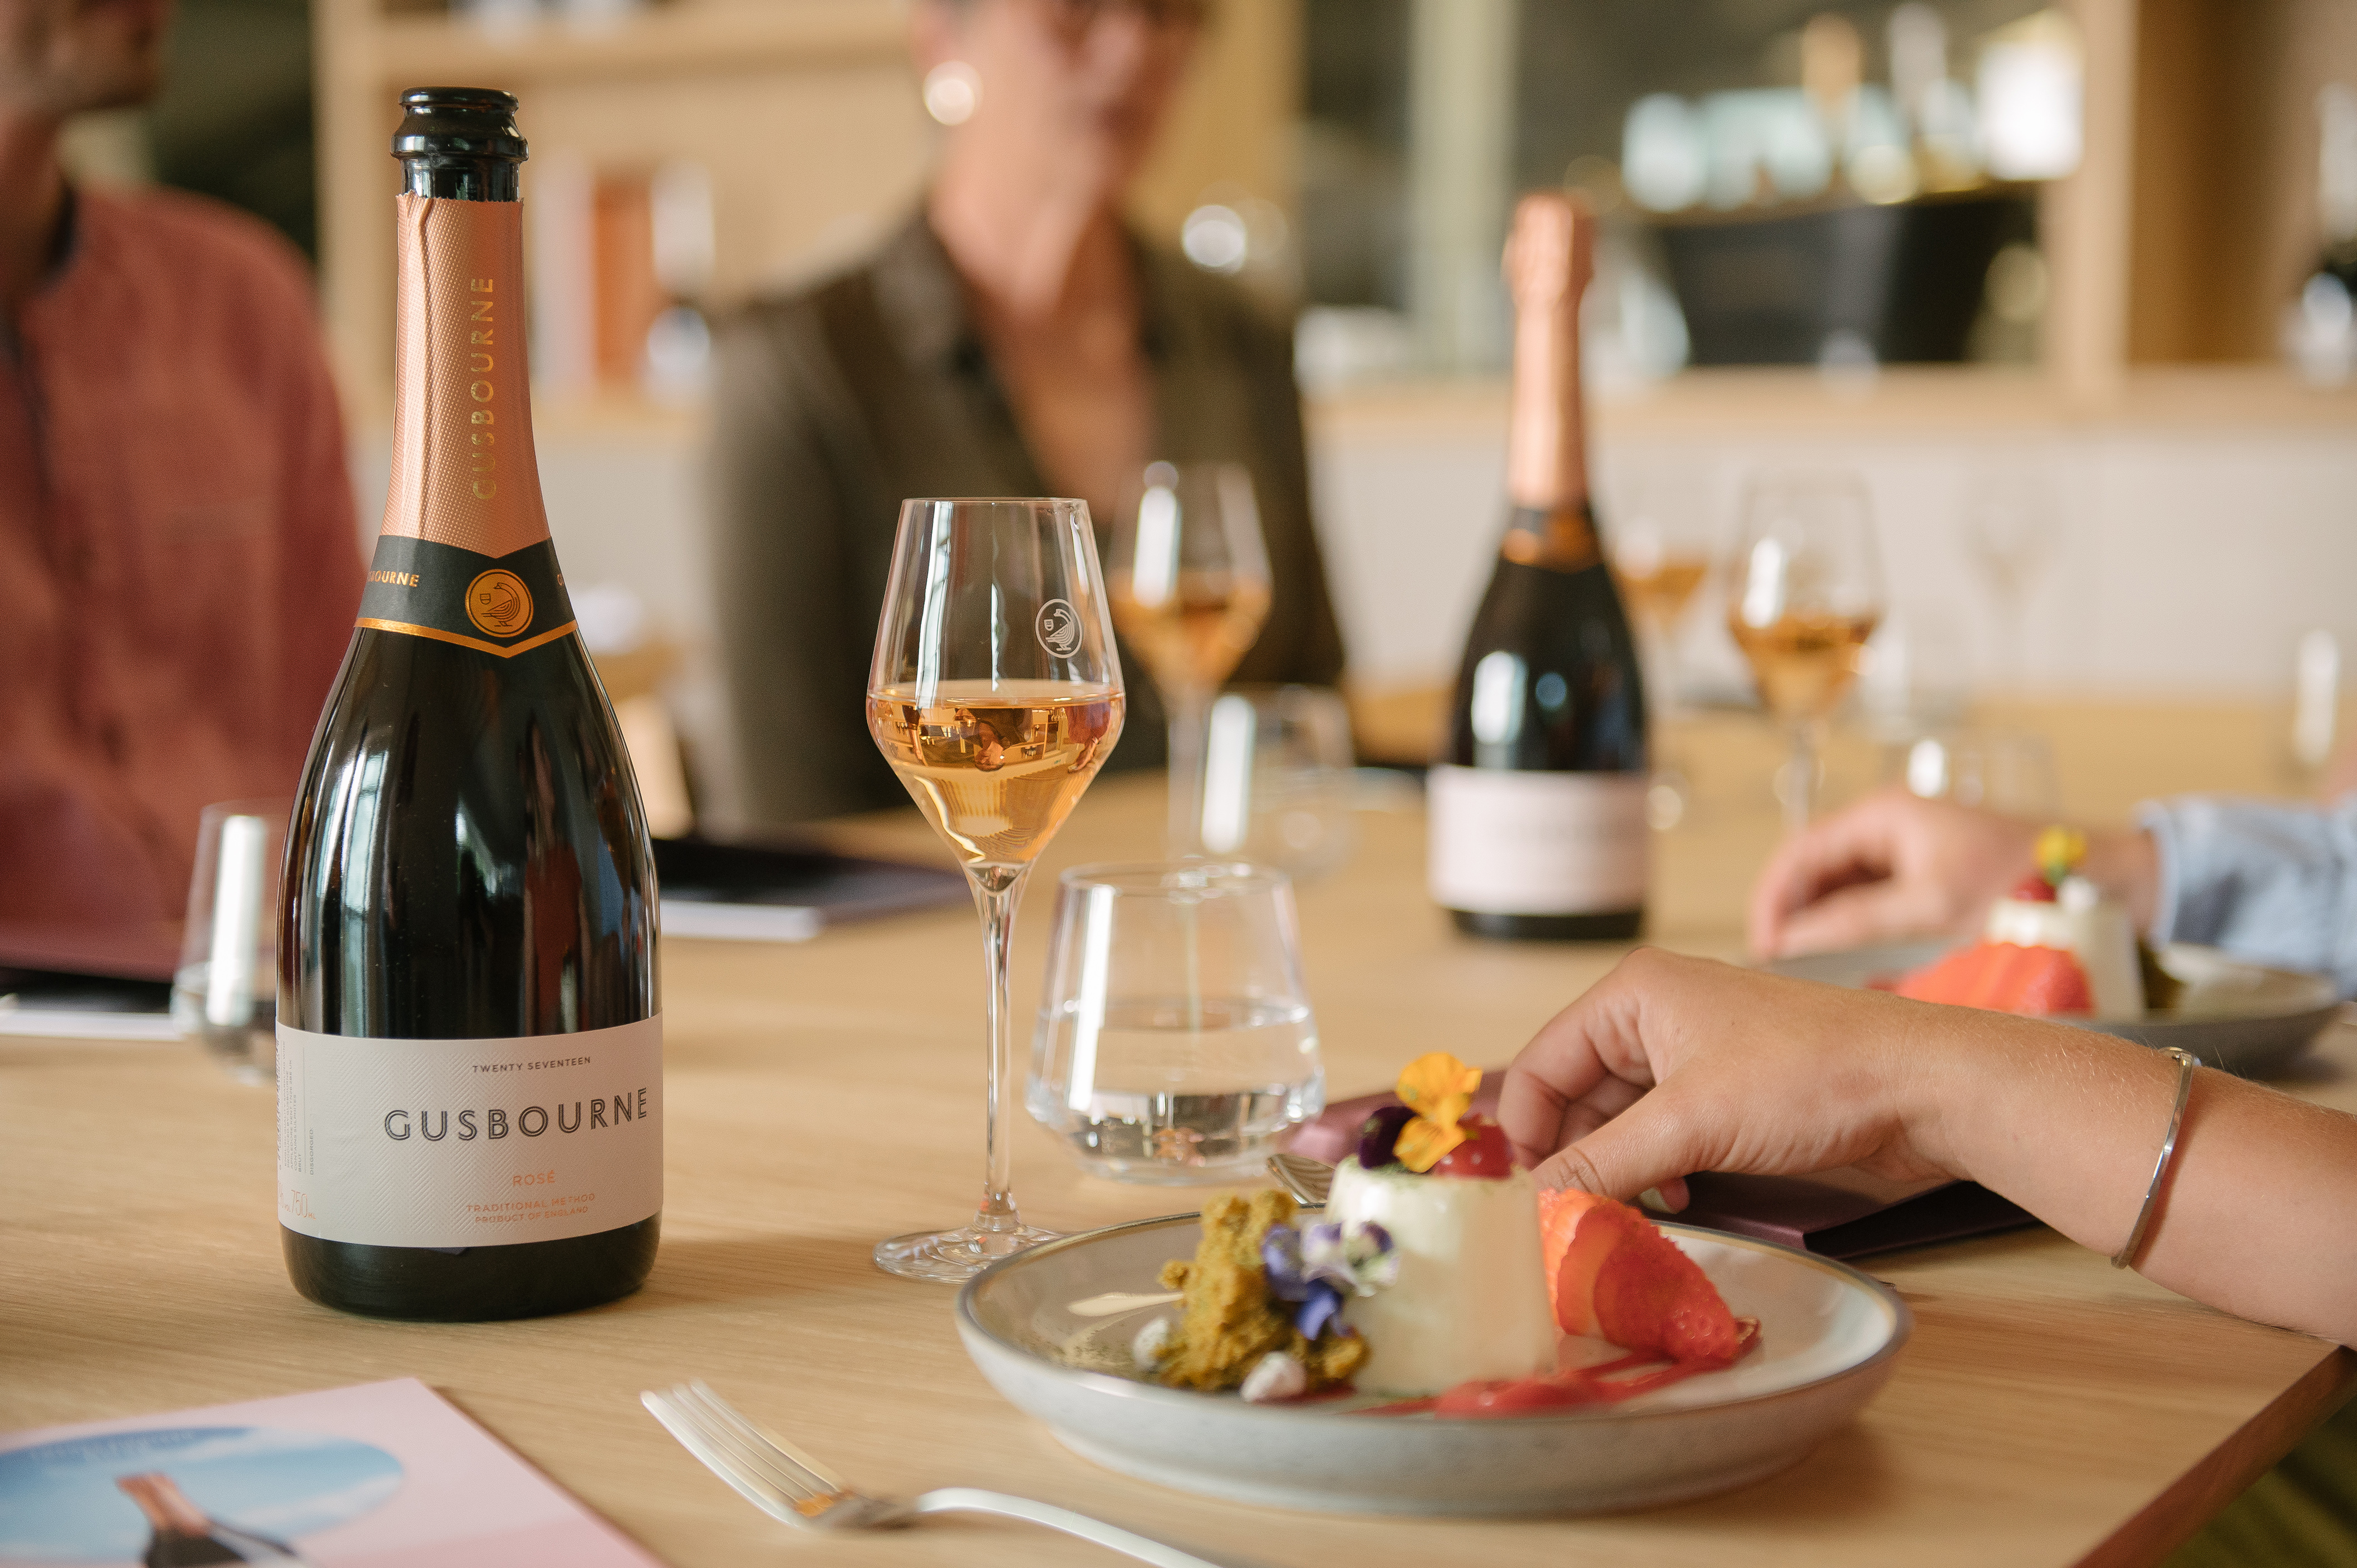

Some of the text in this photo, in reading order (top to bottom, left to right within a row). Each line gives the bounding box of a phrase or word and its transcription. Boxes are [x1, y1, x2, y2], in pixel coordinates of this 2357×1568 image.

[470, 278, 497, 500] GUSBOURNE
[472, 1056, 591, 1073] TWENTY SEVENTEEN
[384, 1087, 647, 1141] GUSBOURNE
[513, 1169, 556, 1187] ROSÉ
[467, 1193, 595, 1212] TRADITIONAL METHOD
[475, 1205, 588, 1223] PRODUCT OF ENGLAND
